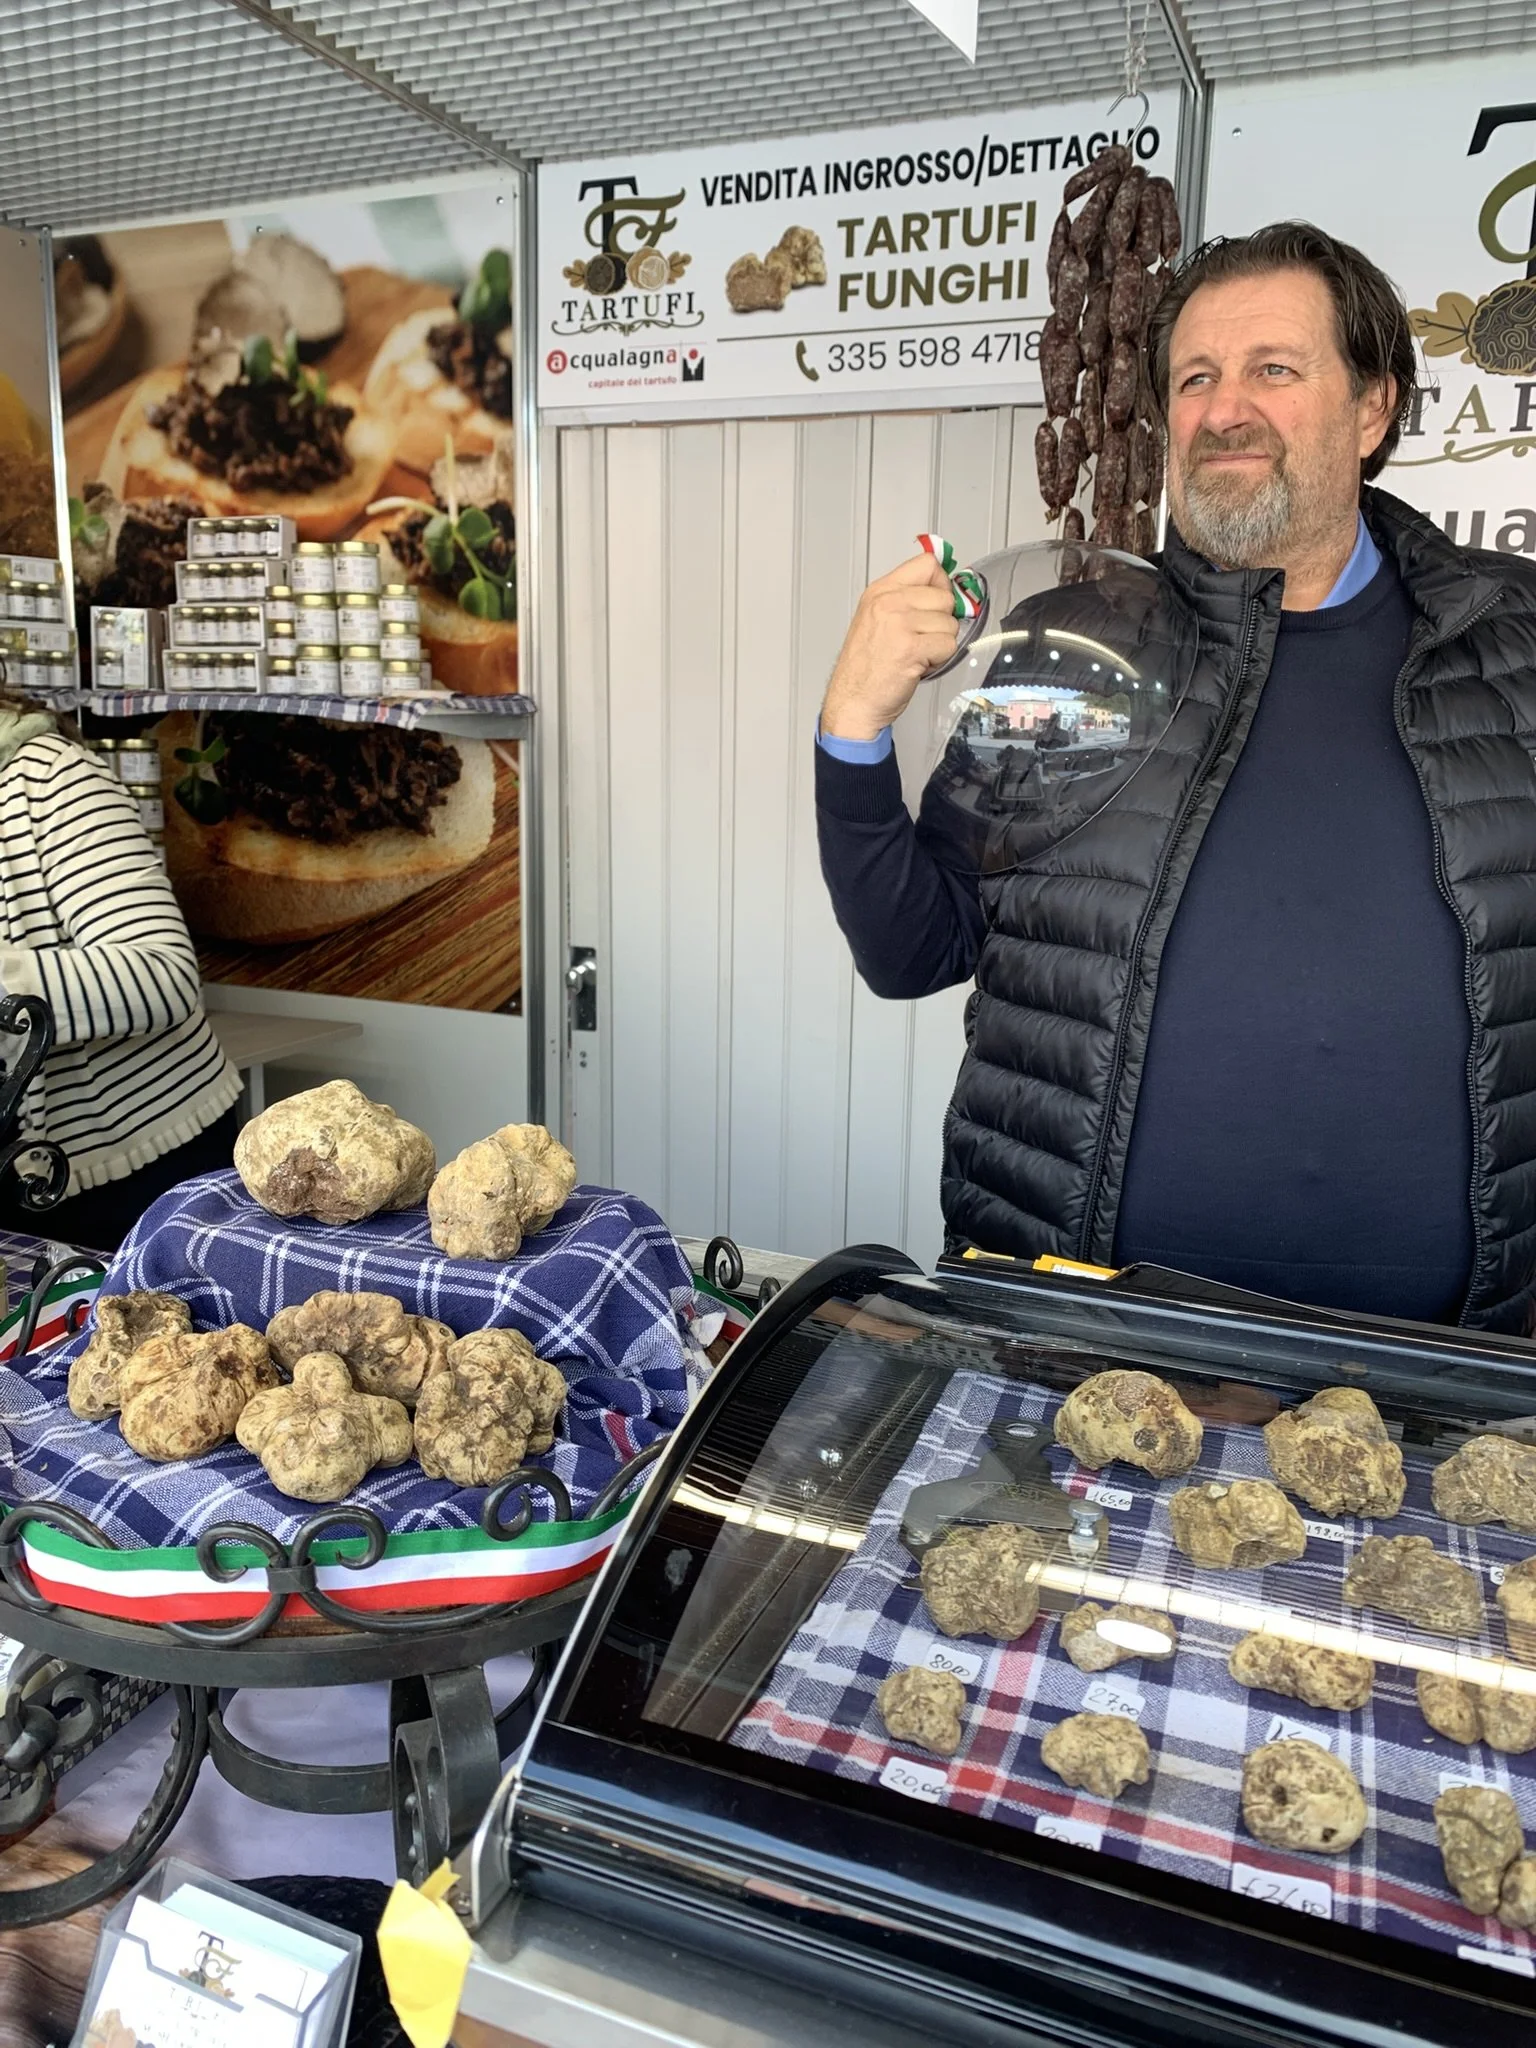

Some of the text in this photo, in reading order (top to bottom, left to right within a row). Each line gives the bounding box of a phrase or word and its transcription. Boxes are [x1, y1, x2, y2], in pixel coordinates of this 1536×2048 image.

[701, 165, 818, 208] VENDITA
[837, 200, 1037, 258] TARTUFI
[561, 291, 695, 323] TARTUFI
[839, 258, 1030, 313] FUNGHI
[546, 347, 677, 374] acqualagna
[828, 330, 1042, 373] 335 598 4718
[588, 375, 678, 389] capitale del tartufo
